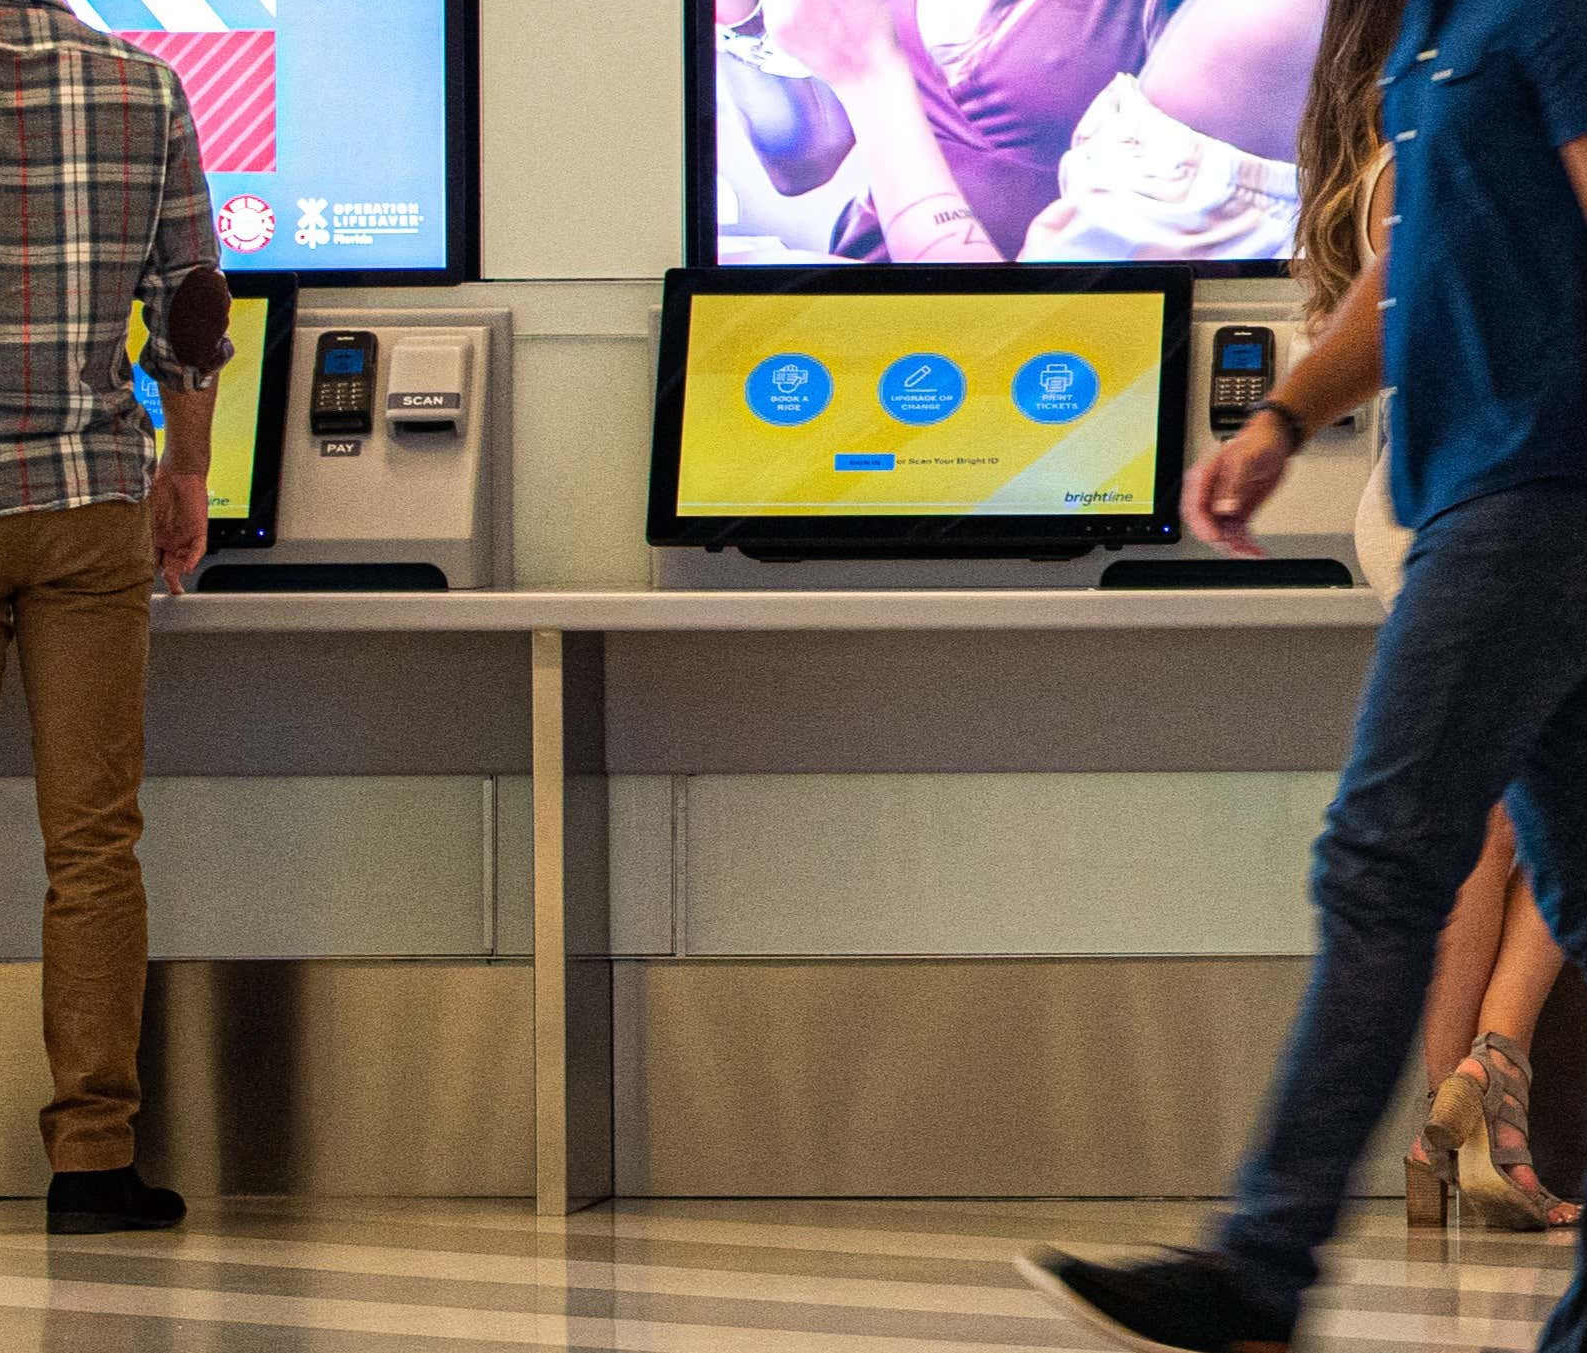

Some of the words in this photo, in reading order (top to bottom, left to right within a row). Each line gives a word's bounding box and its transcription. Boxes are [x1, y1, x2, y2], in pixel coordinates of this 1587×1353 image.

[403, 396, 443, 405] SCAN
[327, 444, 354, 453] PAY
[1064, 491, 1133, 506] brightline
